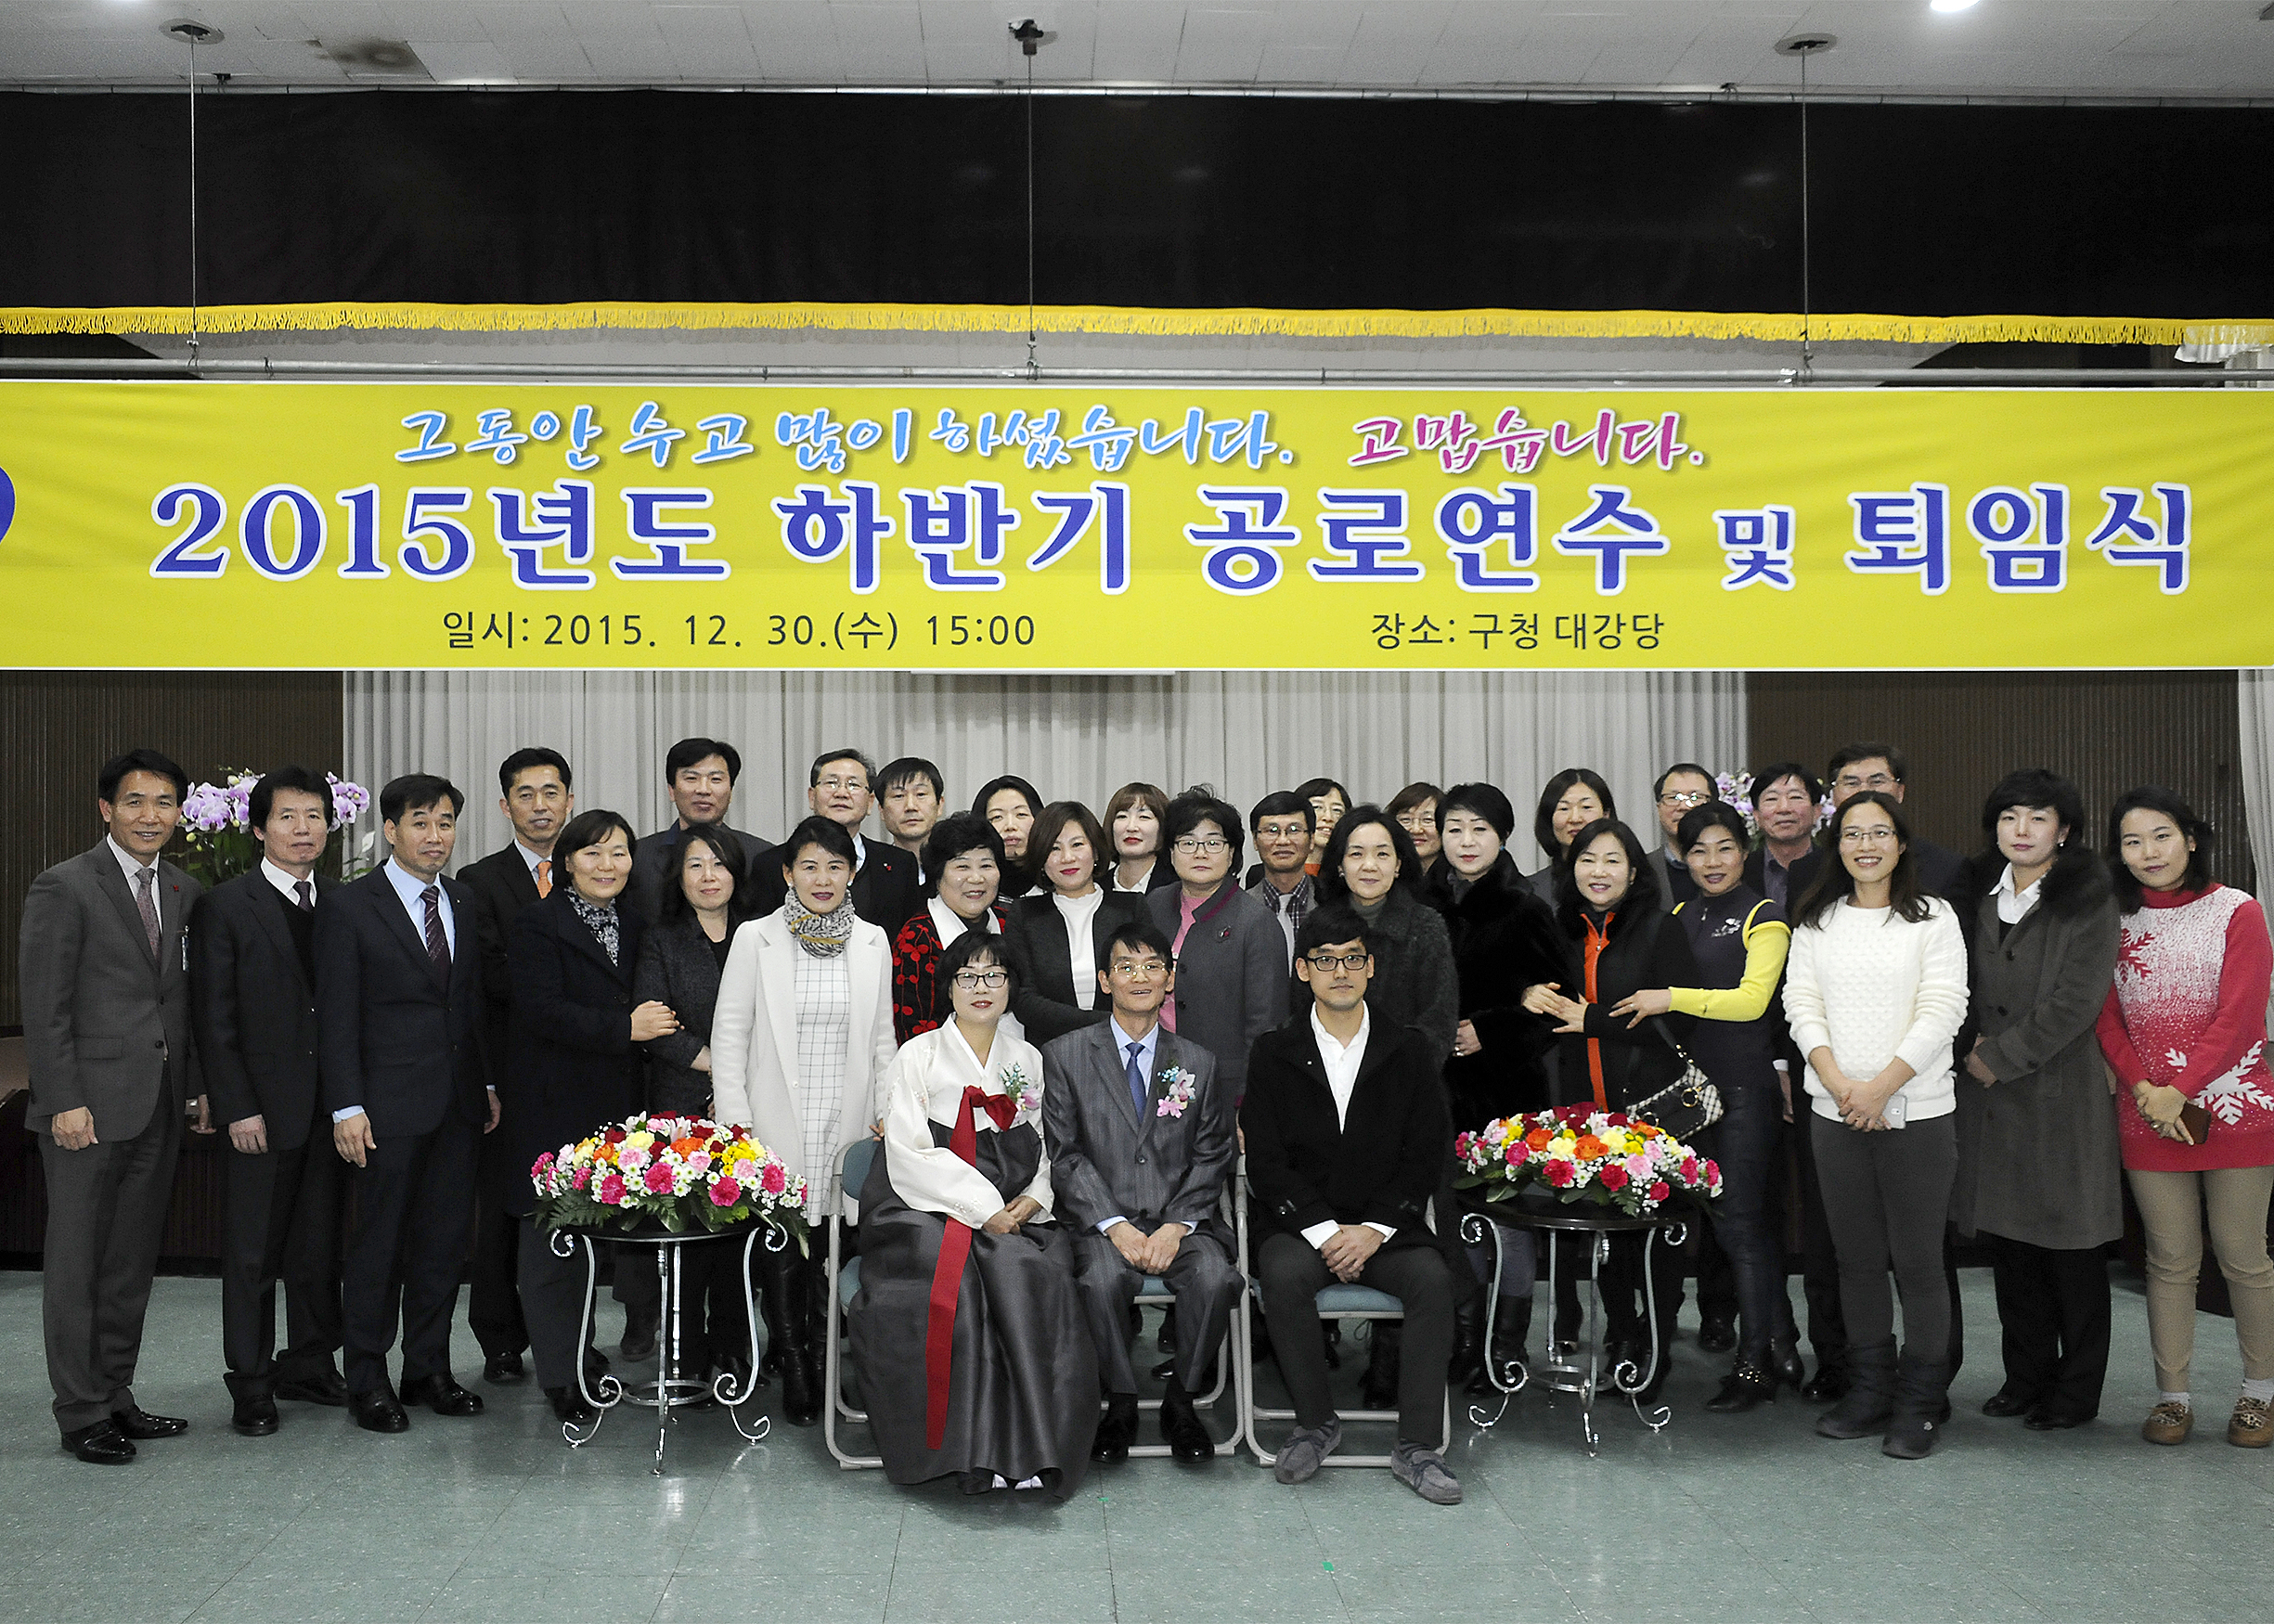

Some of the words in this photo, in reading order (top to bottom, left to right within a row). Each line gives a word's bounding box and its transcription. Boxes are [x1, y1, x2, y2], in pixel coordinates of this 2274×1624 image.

[397, 406, 601, 470] 그동안
[622, 403, 752, 467] 수고
[777, 410, 911, 472] 많이
[932, 407, 1293, 470] 하셨습니다.
[1352, 410, 1702, 471] 고맙습니다.
[154, 483, 728, 587] 2015년도
[775, 485, 1127, 592] 하반기
[1188, 487, 1667, 592] 공로연수
[1719, 509, 1792, 587] 및
[1849, 487, 2189, 592] 퇴임식
[443, 612, 530, 651] 일시:
[544, 615, 657, 649] 2015.
[686, 615, 743, 649] 12.
[768, 612, 899, 651] 30.(수)
[927, 615, 1036, 648] 15:00
[1372, 612, 1456, 651] 장소:
[1469, 613, 1540, 651] 구청
[1556, 613, 1666, 651] 대강당
